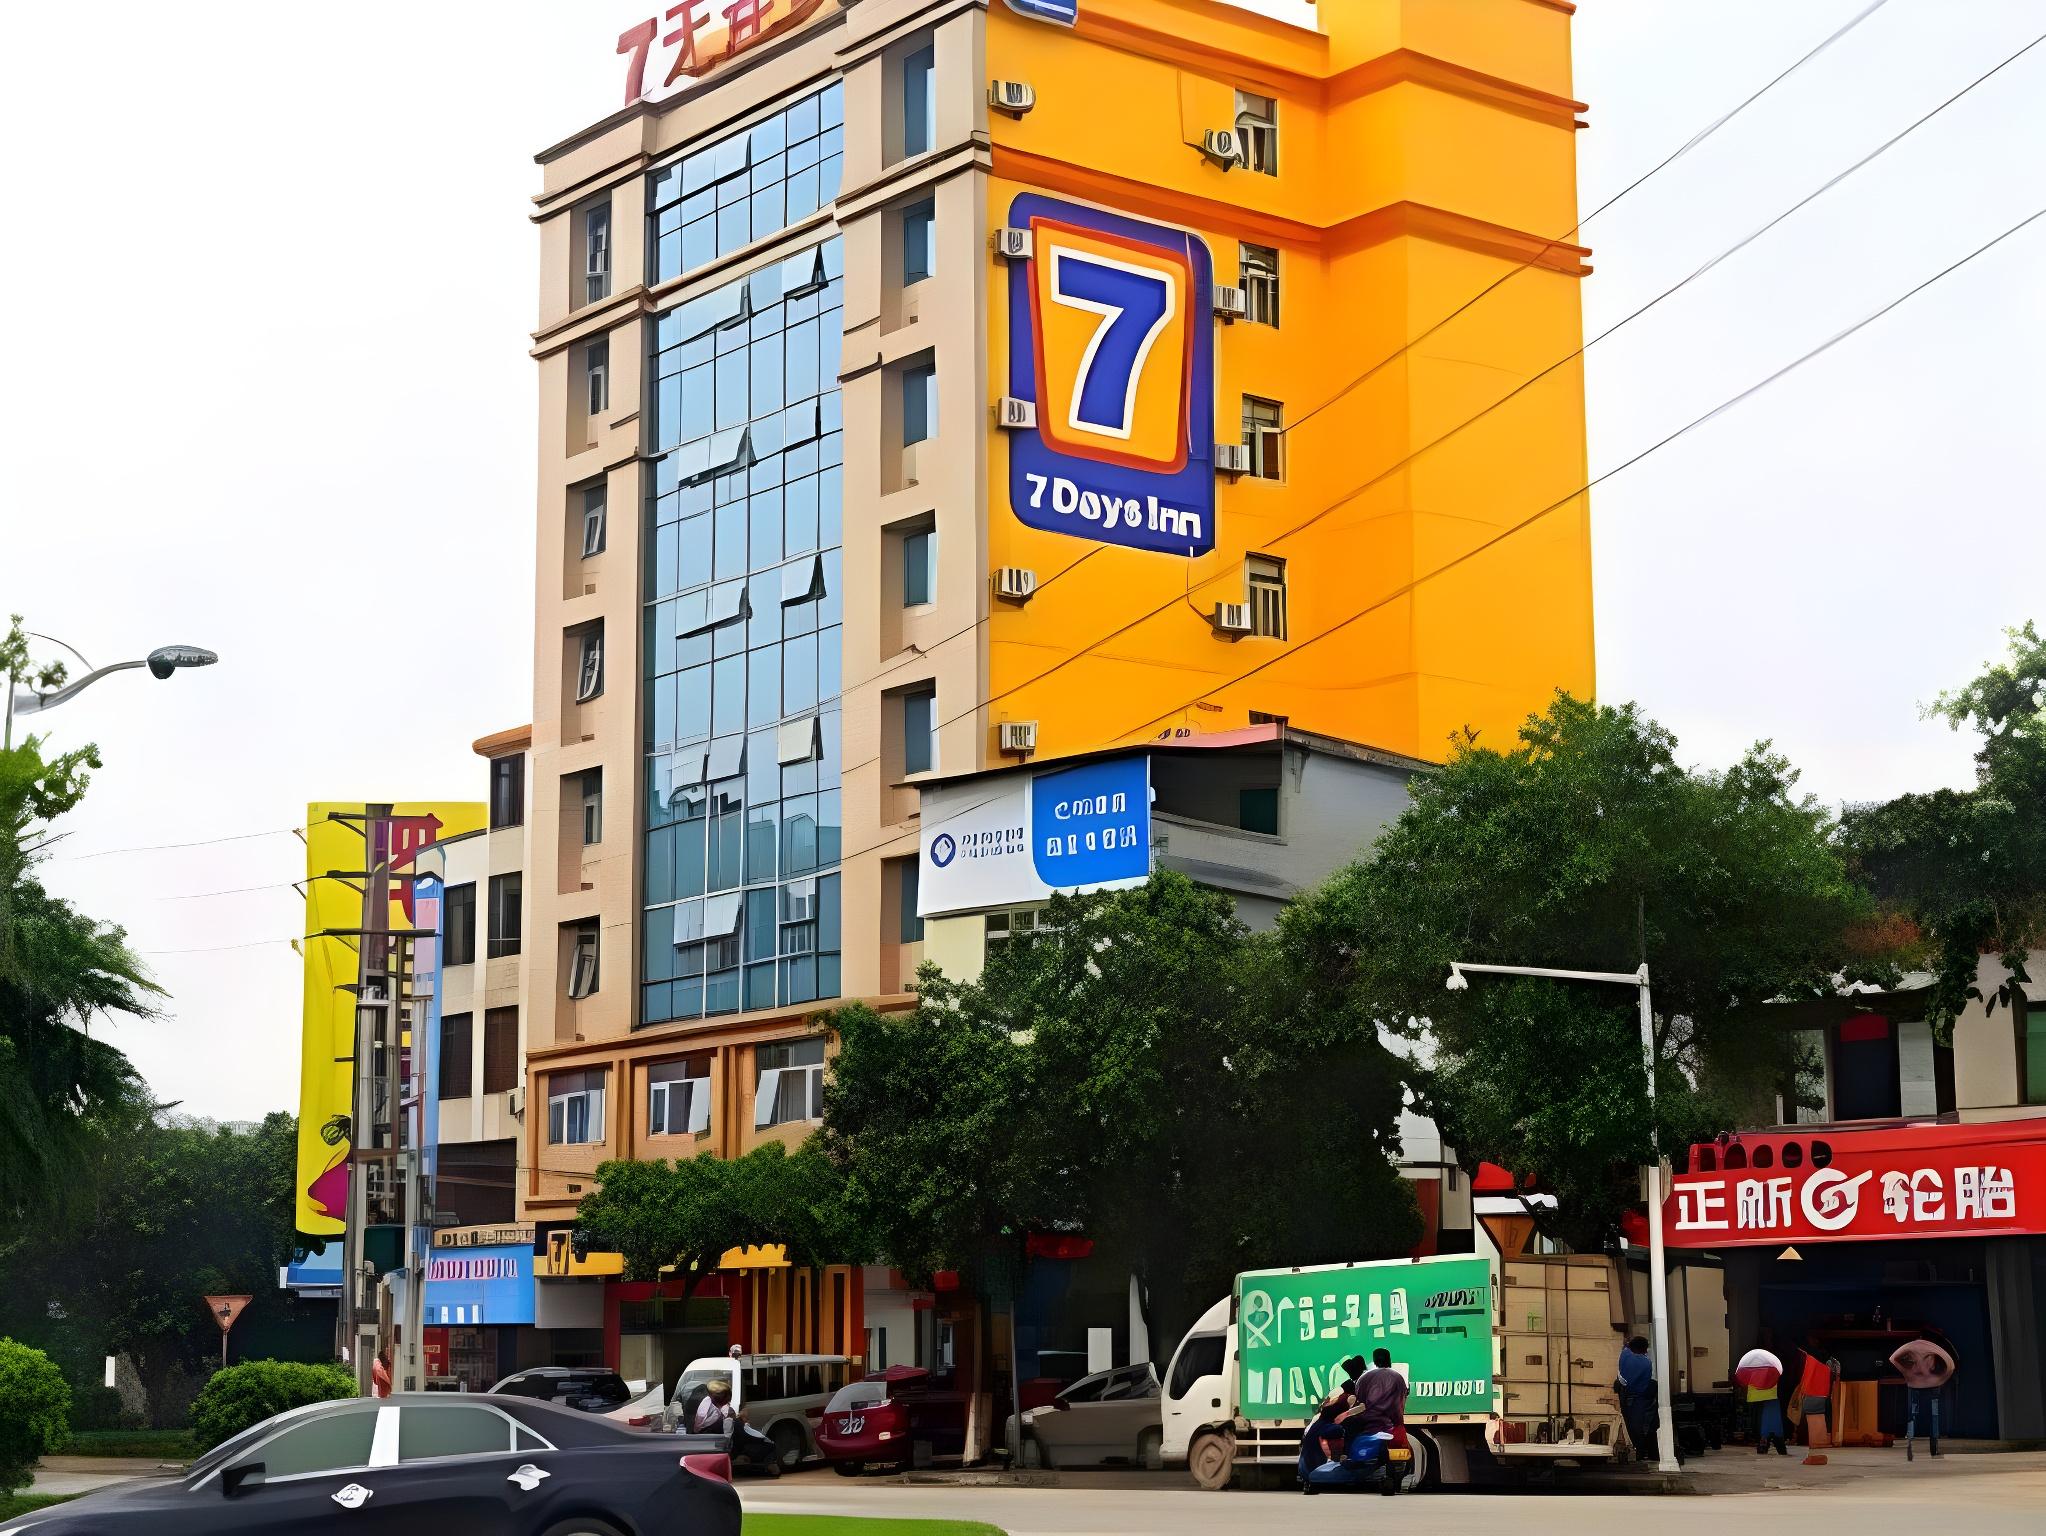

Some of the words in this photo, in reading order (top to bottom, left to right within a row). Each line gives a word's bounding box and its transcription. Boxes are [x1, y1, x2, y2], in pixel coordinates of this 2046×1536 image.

[1050, 244, 1175, 440] 7
[1026, 473, 1048, 509] 7
[1147, 496, 1202, 539] Inn
